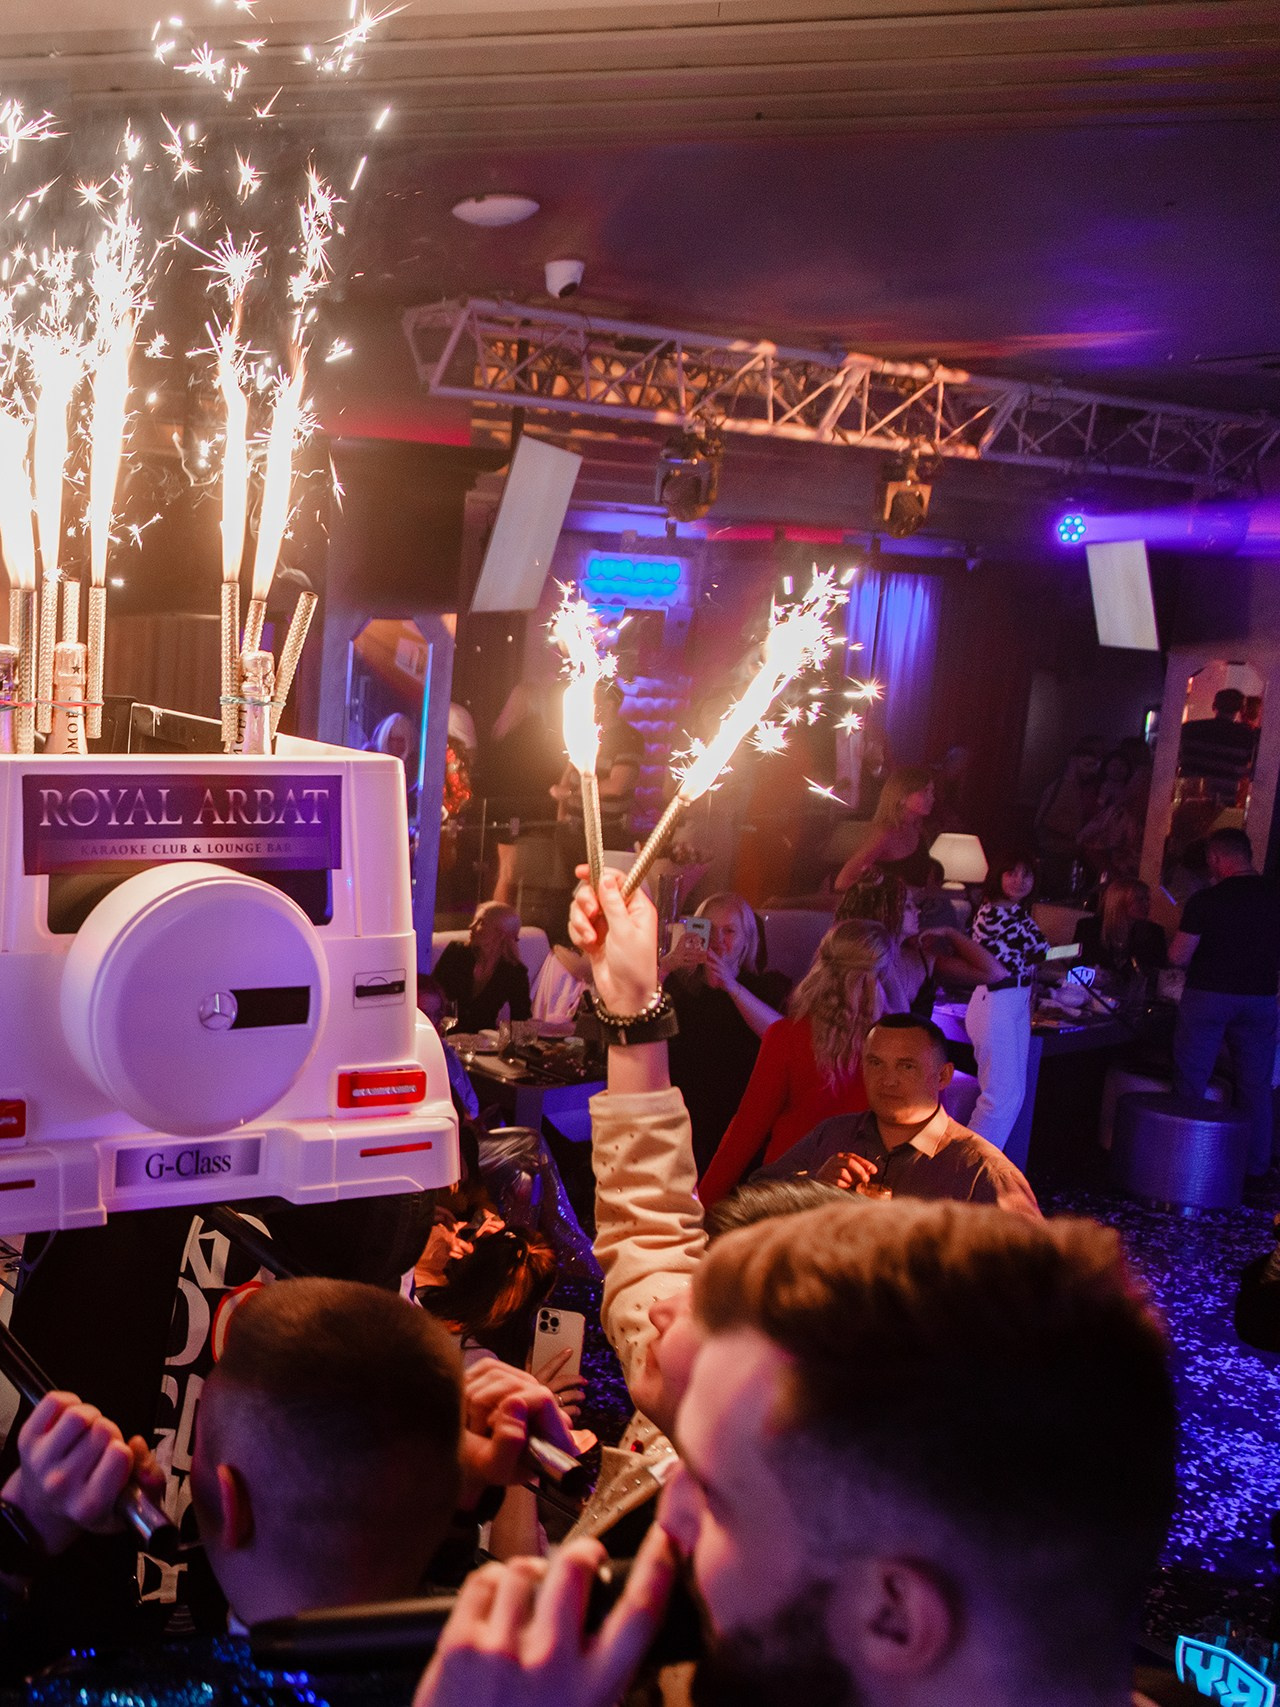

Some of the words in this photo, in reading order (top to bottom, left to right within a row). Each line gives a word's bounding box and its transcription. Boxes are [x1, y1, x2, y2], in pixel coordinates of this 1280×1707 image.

[39, 788, 183, 827] ROYAL
[192, 788, 329, 825] ARBAT
[80, 844, 147, 855] KARAOKE
[152, 844, 187, 854] CLUB
[192, 843, 201, 854] &
[207, 843, 261, 853] LOUNGE
[266, 842, 292, 852] BAR
[145, 1150, 232, 1180] G-Class
